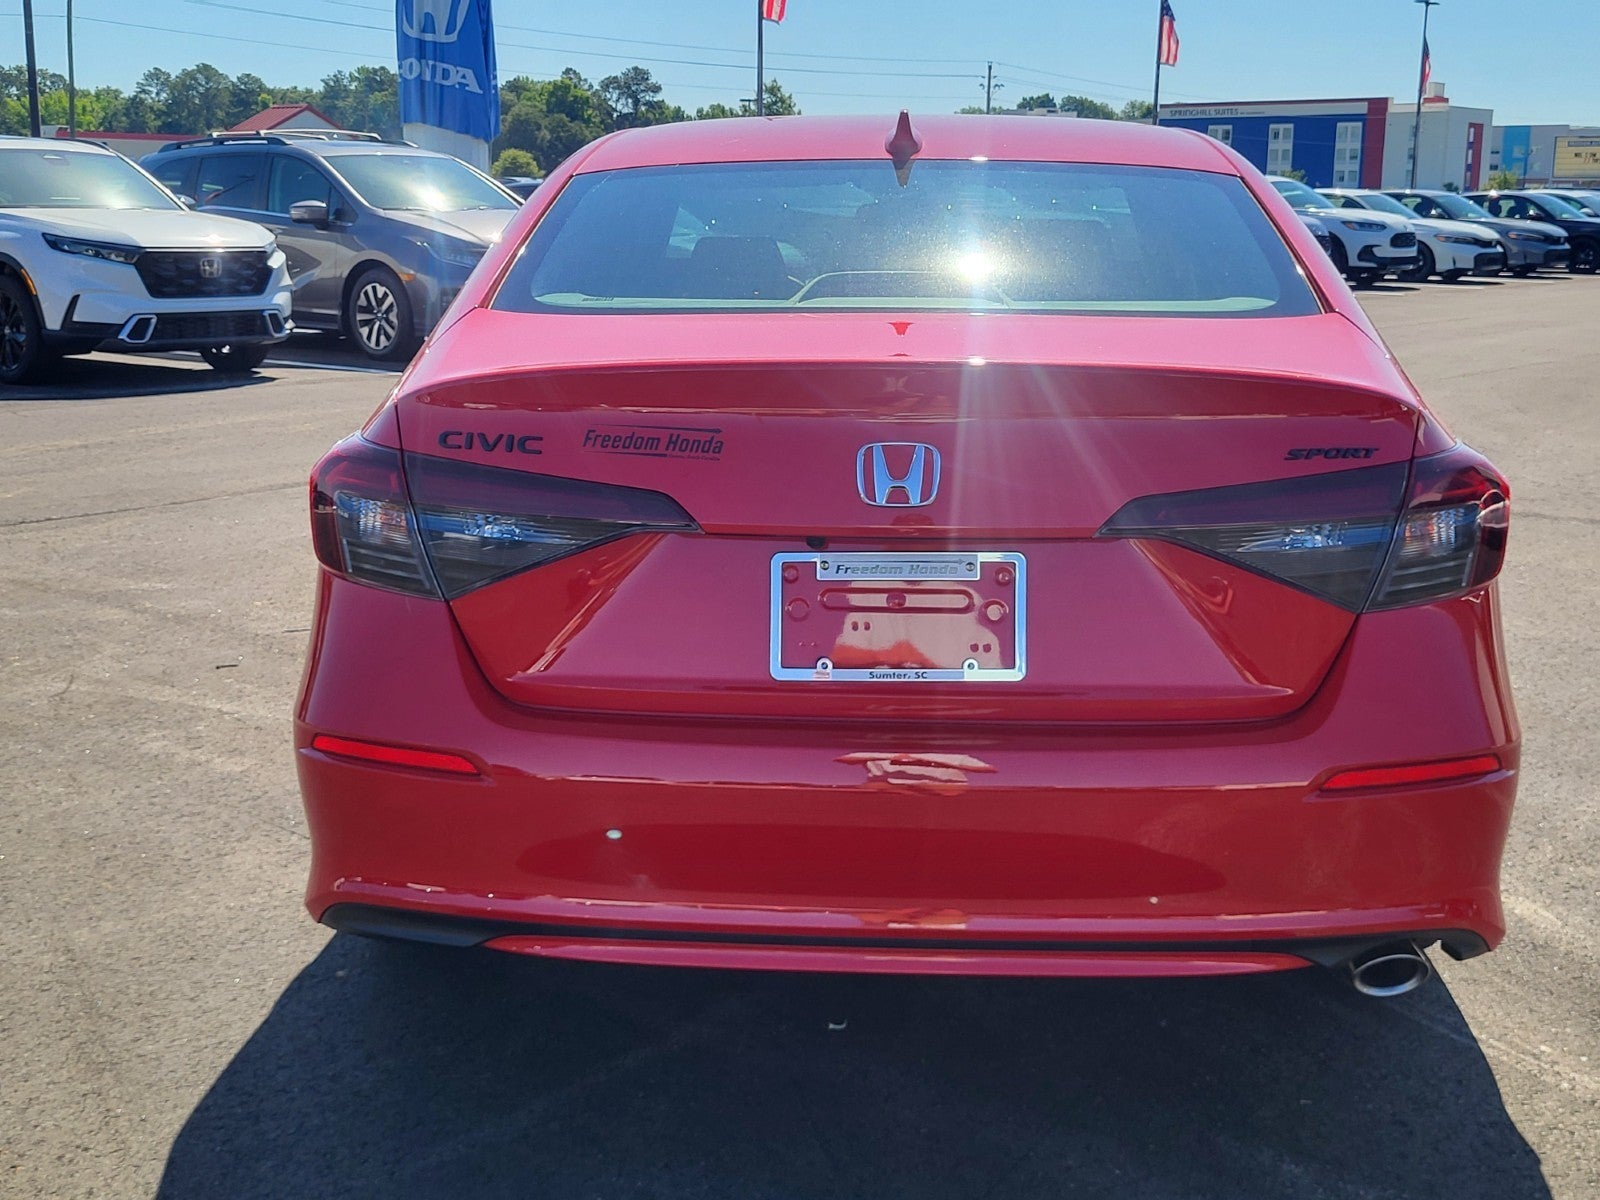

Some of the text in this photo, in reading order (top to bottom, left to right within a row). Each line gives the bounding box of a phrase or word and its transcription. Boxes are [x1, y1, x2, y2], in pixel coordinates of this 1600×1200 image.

[399, 57, 484, 94] ONDA
[1170, 108, 1212, 118] SPRINGHILL
[1214, 107, 1239, 117] SUITES
[438, 430, 543, 455] CIVIC
[582, 429, 724, 454] Freedom Honda
[1284, 446, 1380, 461] SPORT
[835, 563, 959, 575] Freedom Honda
[869, 671, 928, 680] Sumter, SC
